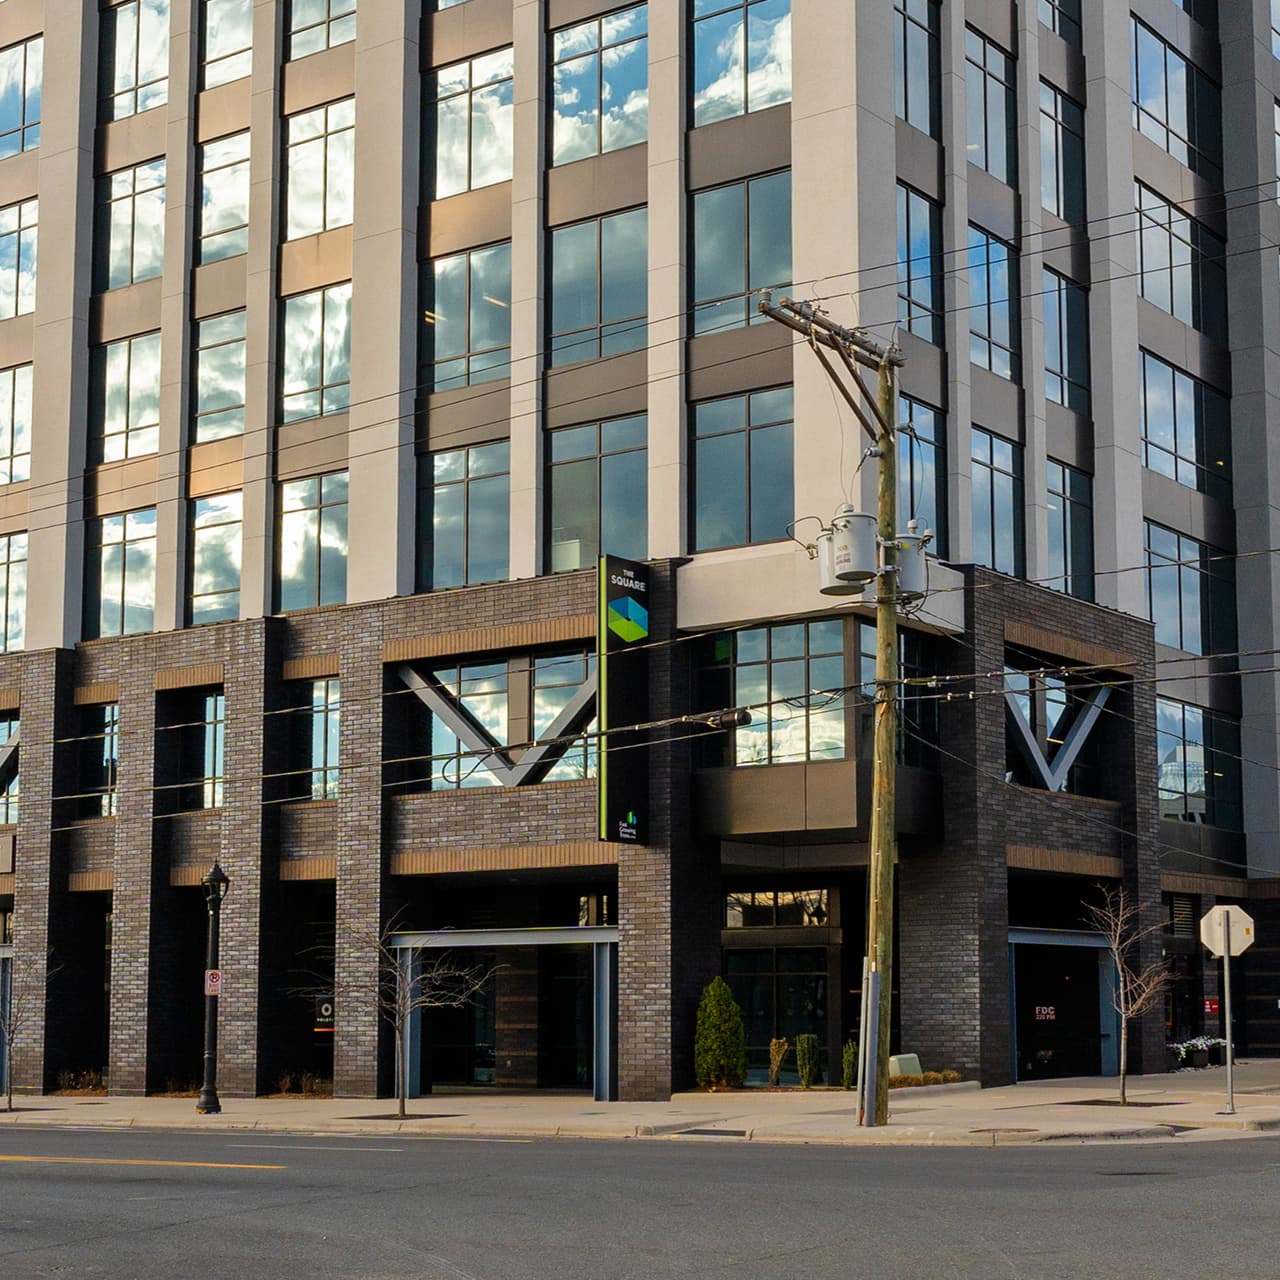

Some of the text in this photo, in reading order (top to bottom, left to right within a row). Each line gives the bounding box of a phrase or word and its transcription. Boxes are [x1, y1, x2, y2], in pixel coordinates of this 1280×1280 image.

[623, 568, 635, 578] THE
[611, 574, 646, 592] SQUARE
[1035, 1006, 1055, 1015] FDC
